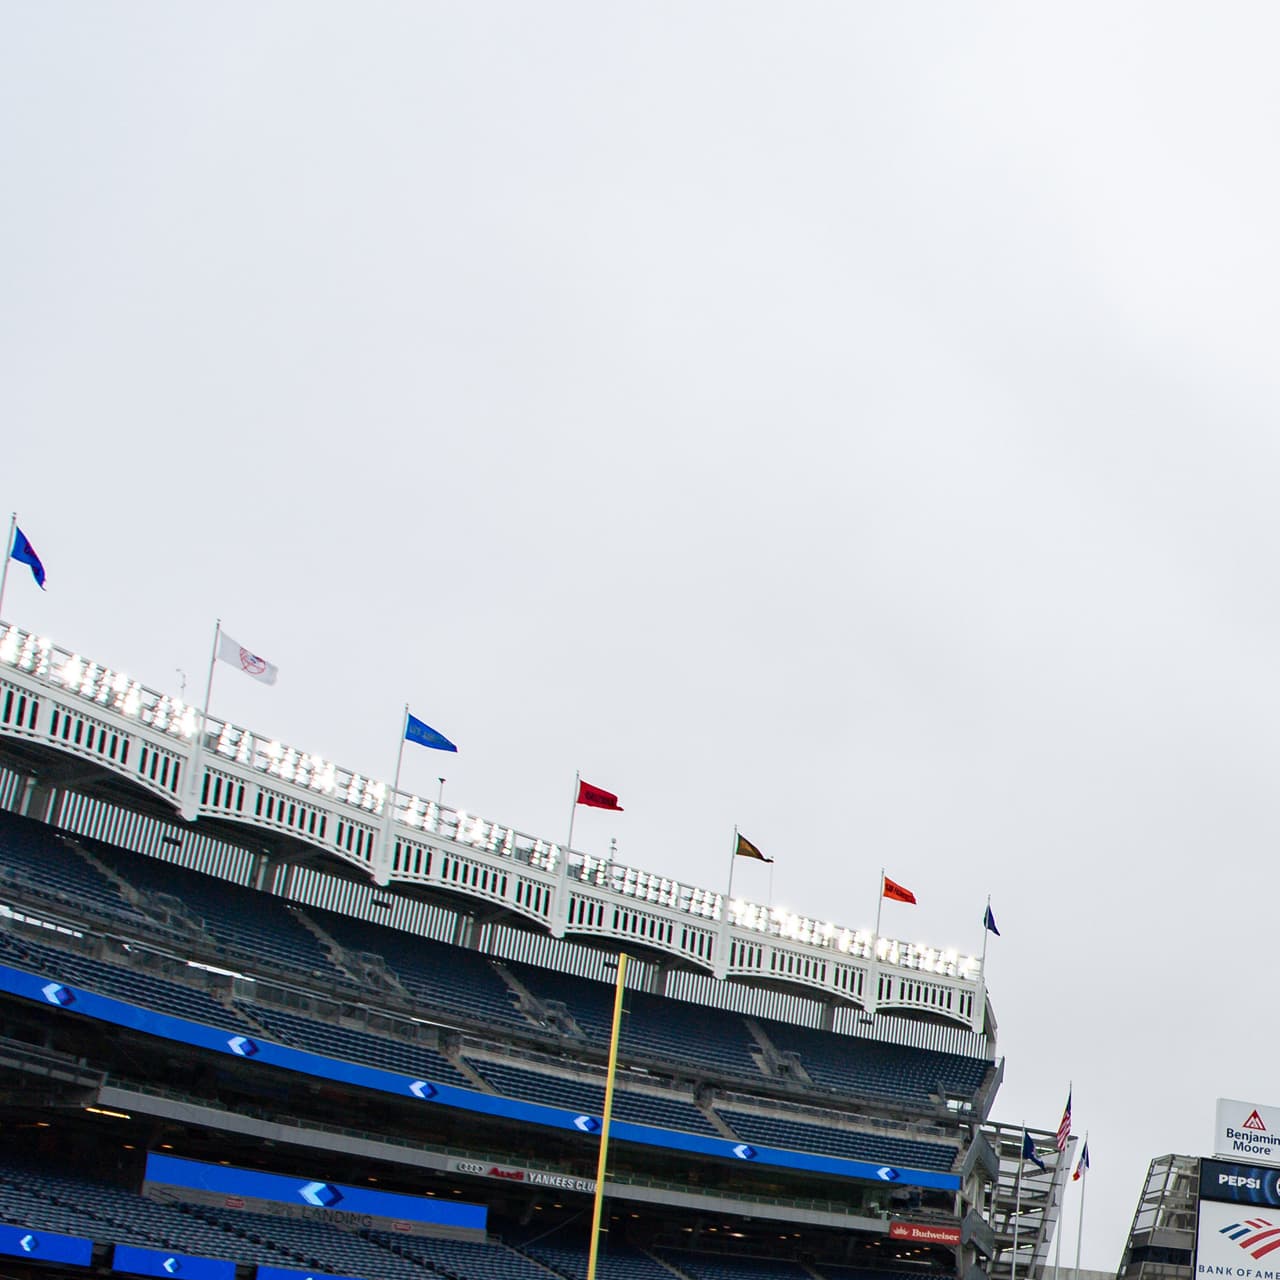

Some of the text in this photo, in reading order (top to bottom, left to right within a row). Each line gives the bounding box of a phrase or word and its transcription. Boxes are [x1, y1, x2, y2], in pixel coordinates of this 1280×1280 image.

[1226, 1128, 1280, 1146] Benjamin
[1233, 1140, 1271, 1155] Moore
[528, 1171, 574, 1189] YANKEES
[1218, 1173, 1261, 1189] PEPSI
[302, 1207, 373, 1228] LANDING
[912, 1228, 960, 1241] Budweiser
[1198, 1264, 1233, 1277] BANK
[1236, 1268, 1252, 1277] OF
